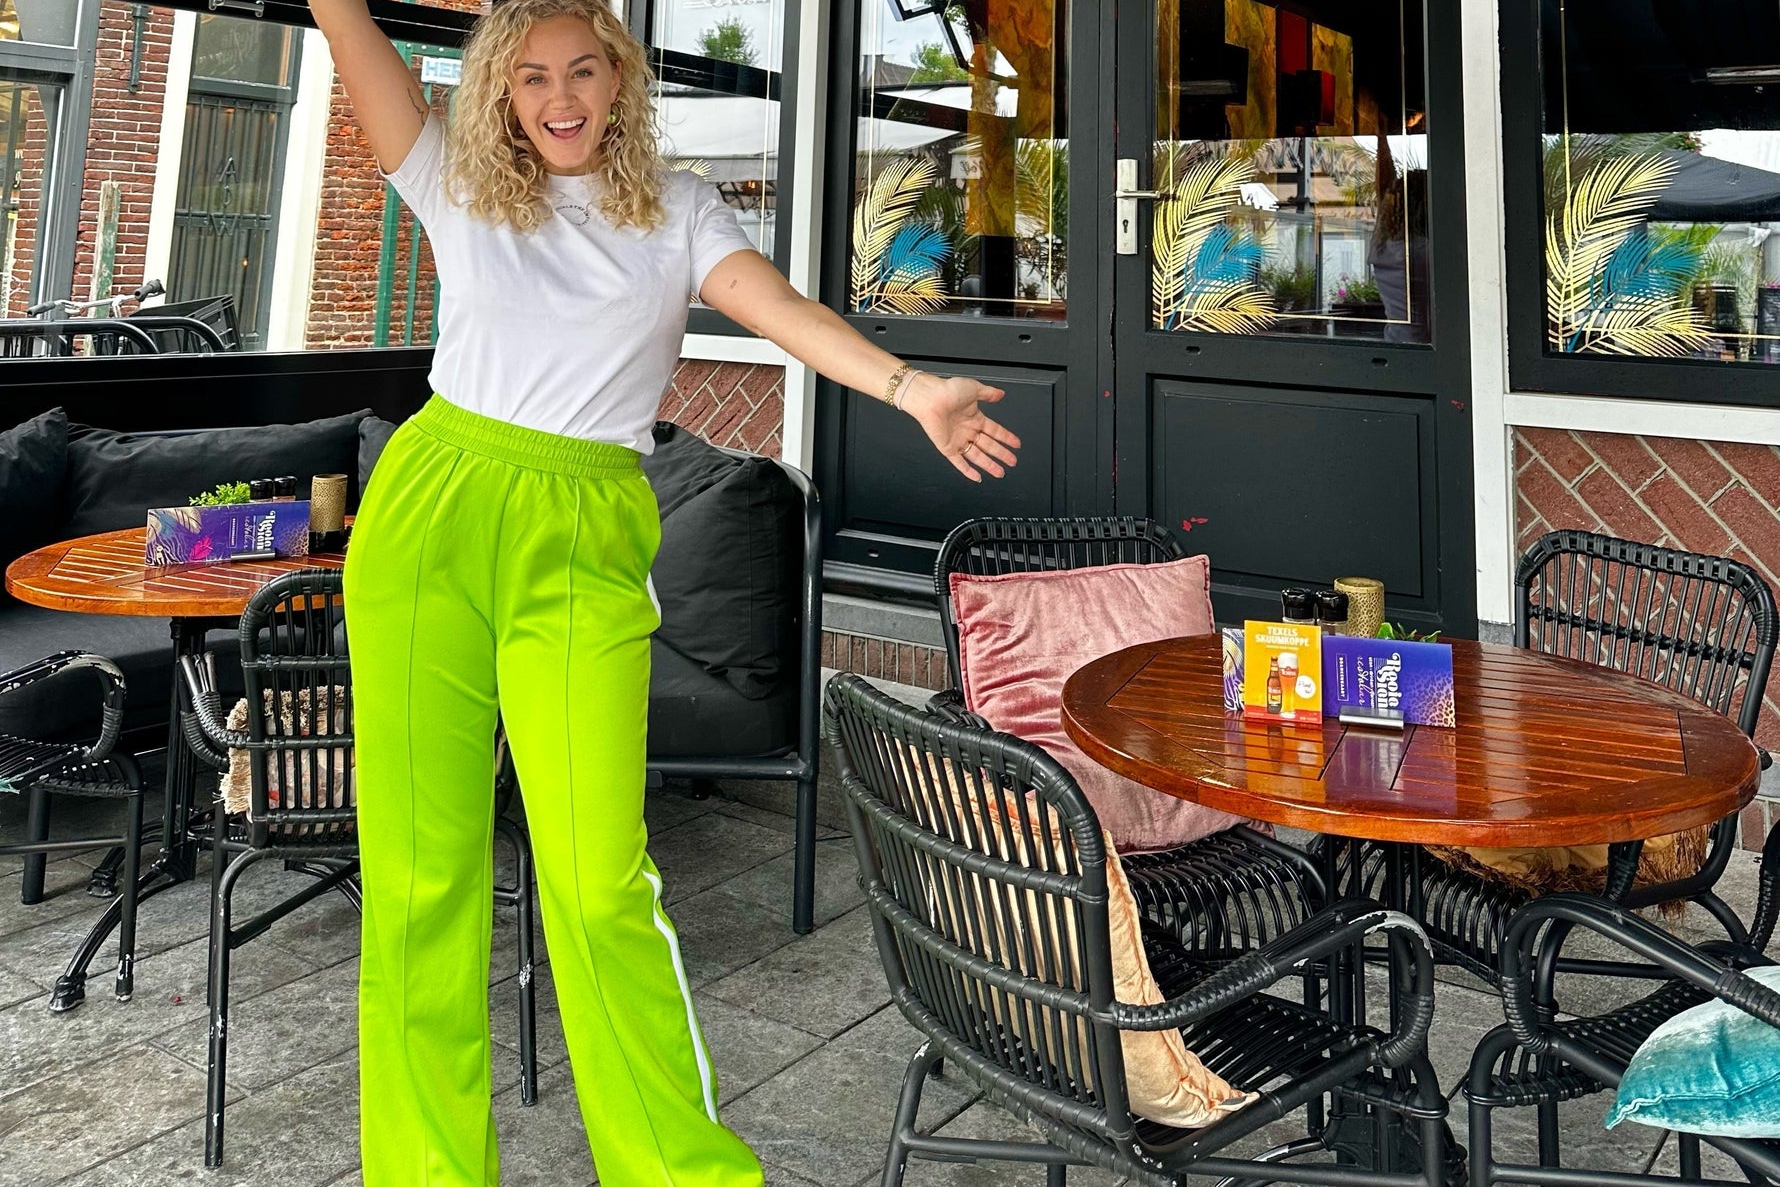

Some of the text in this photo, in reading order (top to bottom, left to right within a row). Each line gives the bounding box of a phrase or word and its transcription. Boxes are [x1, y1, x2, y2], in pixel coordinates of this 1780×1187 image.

[1255, 634, 1310, 647] SKUUMKOPPE
[1267, 626, 1298, 636] TEXELS
[1377, 669, 1388, 708] Sien
[1378, 652, 1402, 707] Rooie
